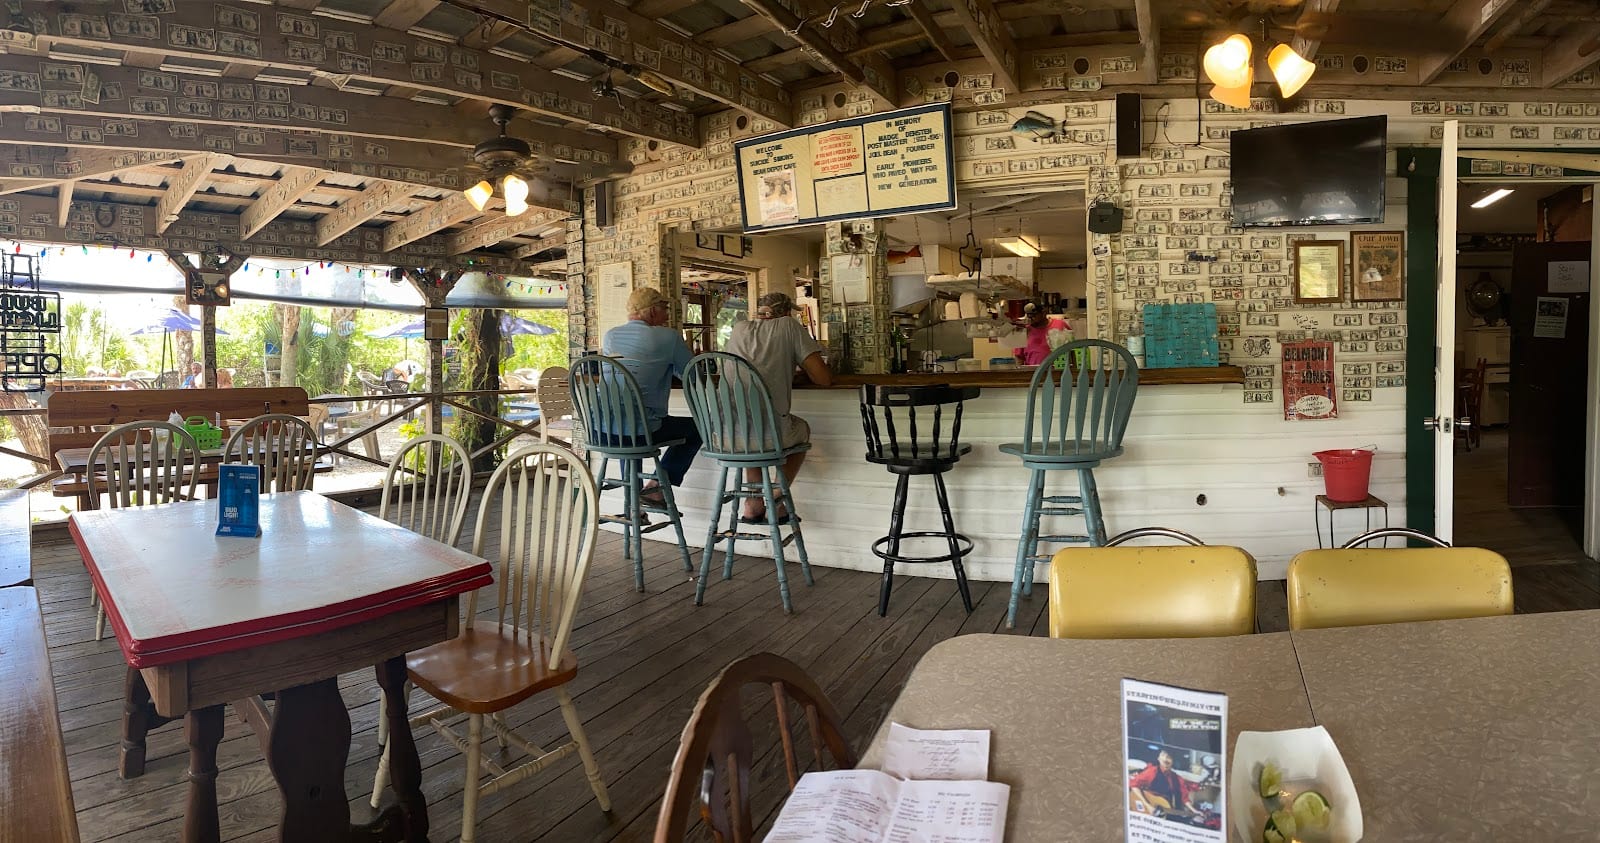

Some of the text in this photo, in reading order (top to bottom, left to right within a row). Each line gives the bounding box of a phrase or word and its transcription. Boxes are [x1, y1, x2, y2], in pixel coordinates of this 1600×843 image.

[895, 117, 921, 126] MEMORY
[884, 138, 908, 148] MASTER
[906, 144, 935, 152] FOUNDER
[756, 144, 783, 154] WELCOME
[876, 158, 932, 170] EARLY PIONEERS
[898, 177, 937, 188] GENERATION
[1284, 348, 1329, 362] BELMONT
[1302, 370, 1332, 384] JONES
